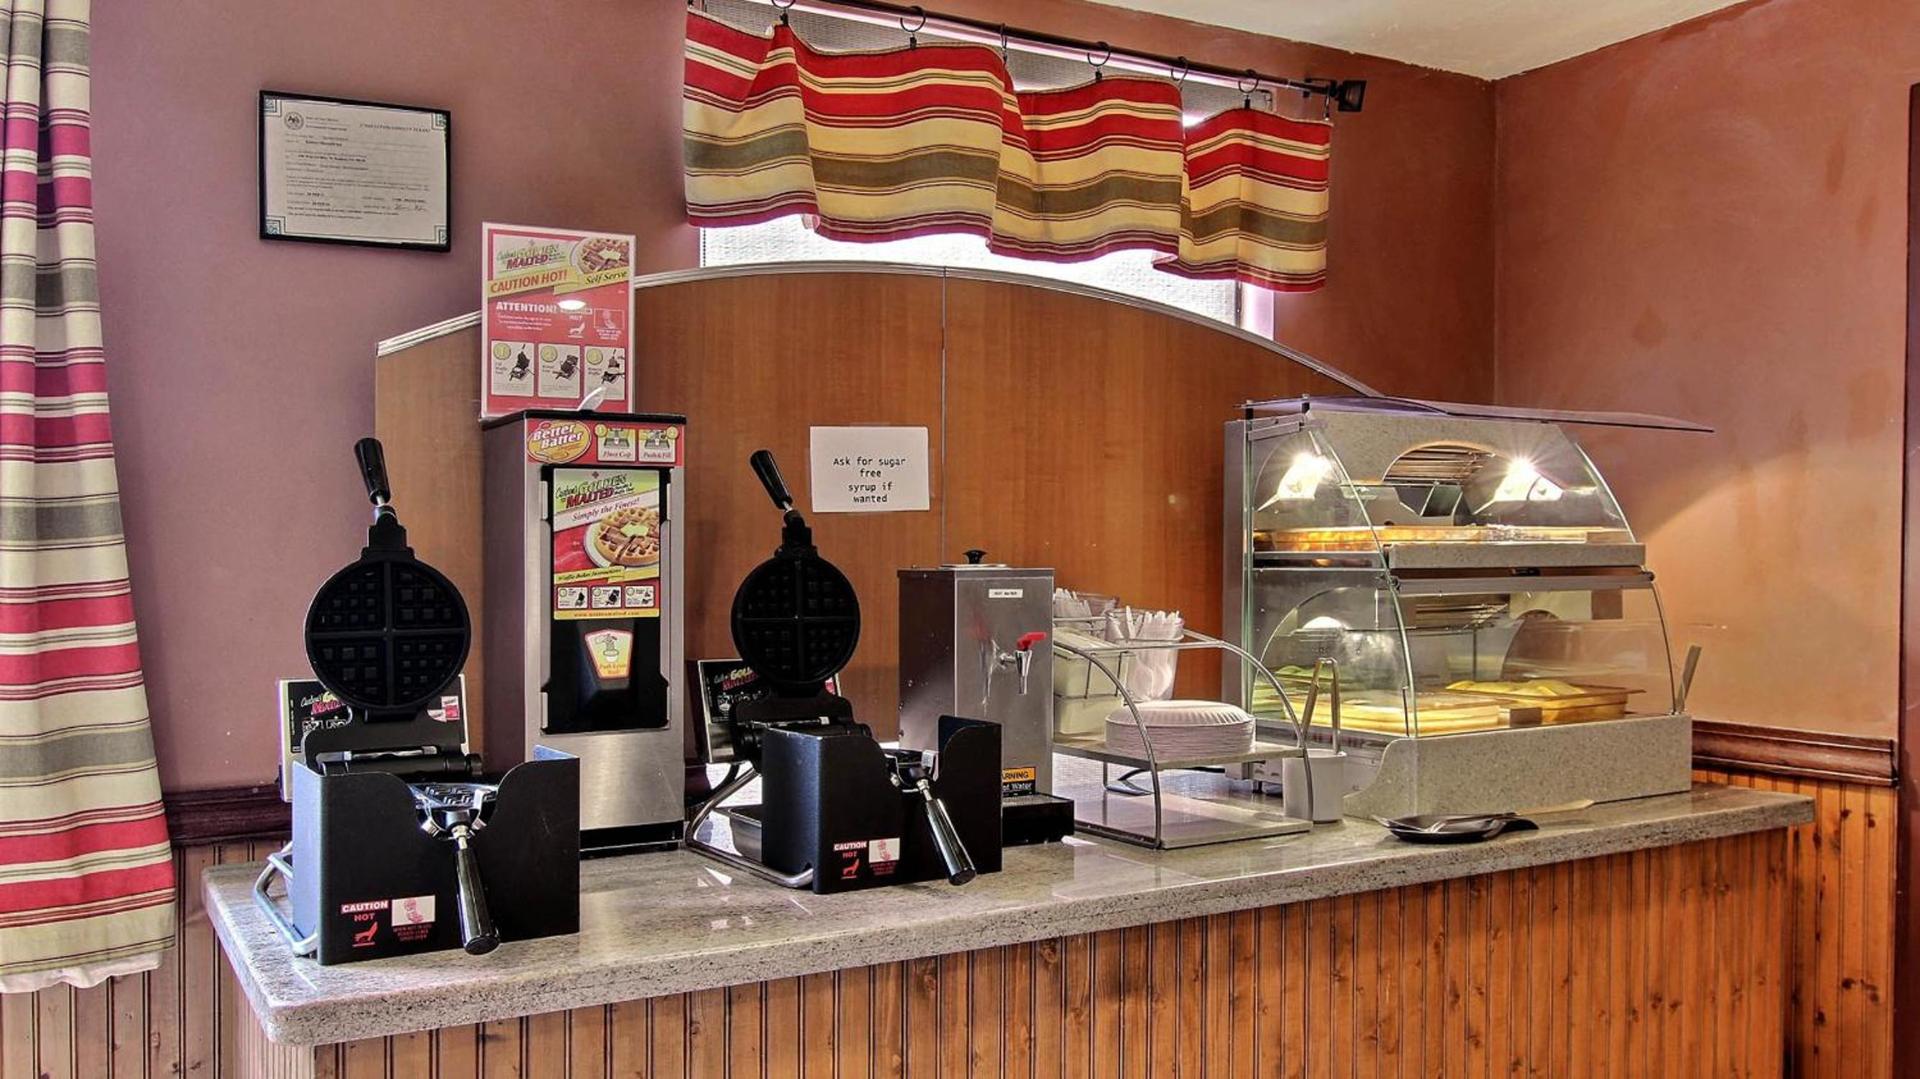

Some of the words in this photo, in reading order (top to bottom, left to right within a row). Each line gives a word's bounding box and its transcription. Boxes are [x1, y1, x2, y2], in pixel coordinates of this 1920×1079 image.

[507, 254, 549, 270] MALTED
[490, 277, 539, 294] CAUTION
[541, 269, 568, 283] HOT!
[585, 275, 602, 285] Self
[604, 270, 628, 281] Serve
[496, 301, 557, 314] ATTENTION!
[533, 425, 576, 441] Better
[541, 433, 583, 450] Batter
[833, 456, 850, 466] Ask
[857, 456, 873, 466] for
[879, 458, 906, 468] sugar
[860, 468, 881, 478] free
[848, 483, 876, 493] syrup
[882, 482, 893, 491] if
[565, 487, 615, 509] MALTED
[853, 494, 888, 503] wanted
[572, 508, 599, 522] Simply
[600, 502, 613, 514] the
[614, 497, 640, 511] Finest!
[834, 841, 867, 851] CAUTION
[843, 851, 857, 859] HOT
[342, 901, 388, 913] CAUTION
[354, 913, 376, 921] HOT
